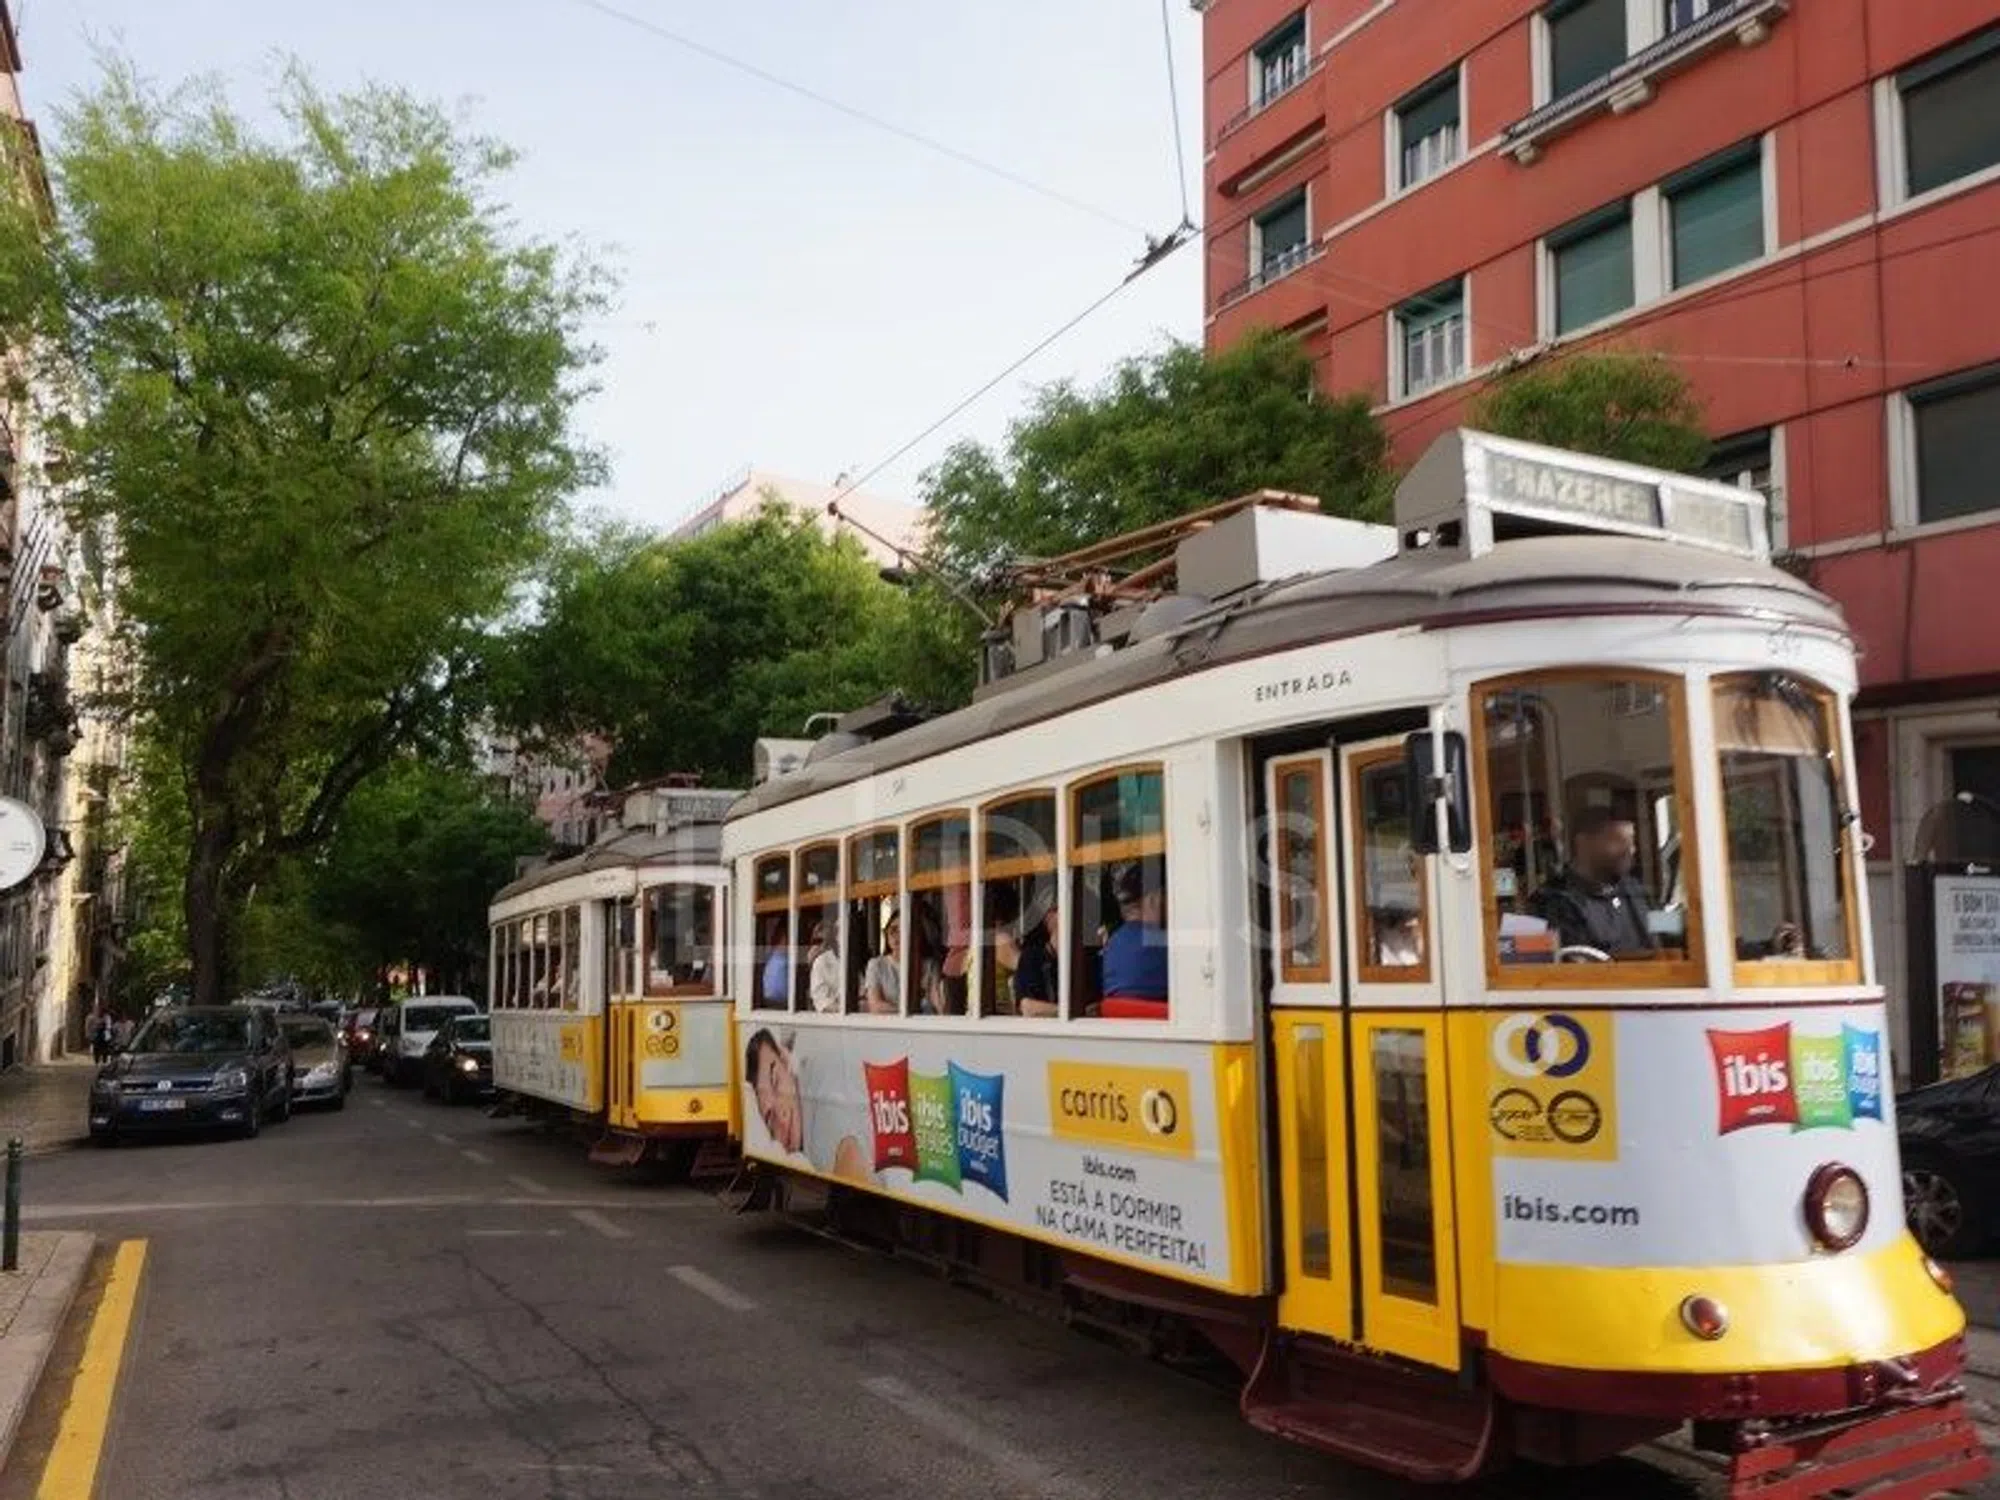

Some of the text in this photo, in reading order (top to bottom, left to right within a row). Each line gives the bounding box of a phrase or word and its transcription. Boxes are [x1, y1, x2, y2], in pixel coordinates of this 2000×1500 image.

[1255, 669, 1353, 702] ENTRADA
[1722, 1052, 1789, 1097] ibis
[873, 1090, 909, 1134] ibis
[916, 1092, 946, 1129] ibis
[959, 1087, 992, 1132] ibis
[1061, 1082, 1129, 1122] carris
[1083, 1155, 1136, 1183] ibis.com
[1050, 1179, 1182, 1230] ESTÁ A DORMIR
[1504, 1195, 1640, 1226] ibis.com
[1036, 1204, 1207, 1271] NA CAMA PERFEITA!
